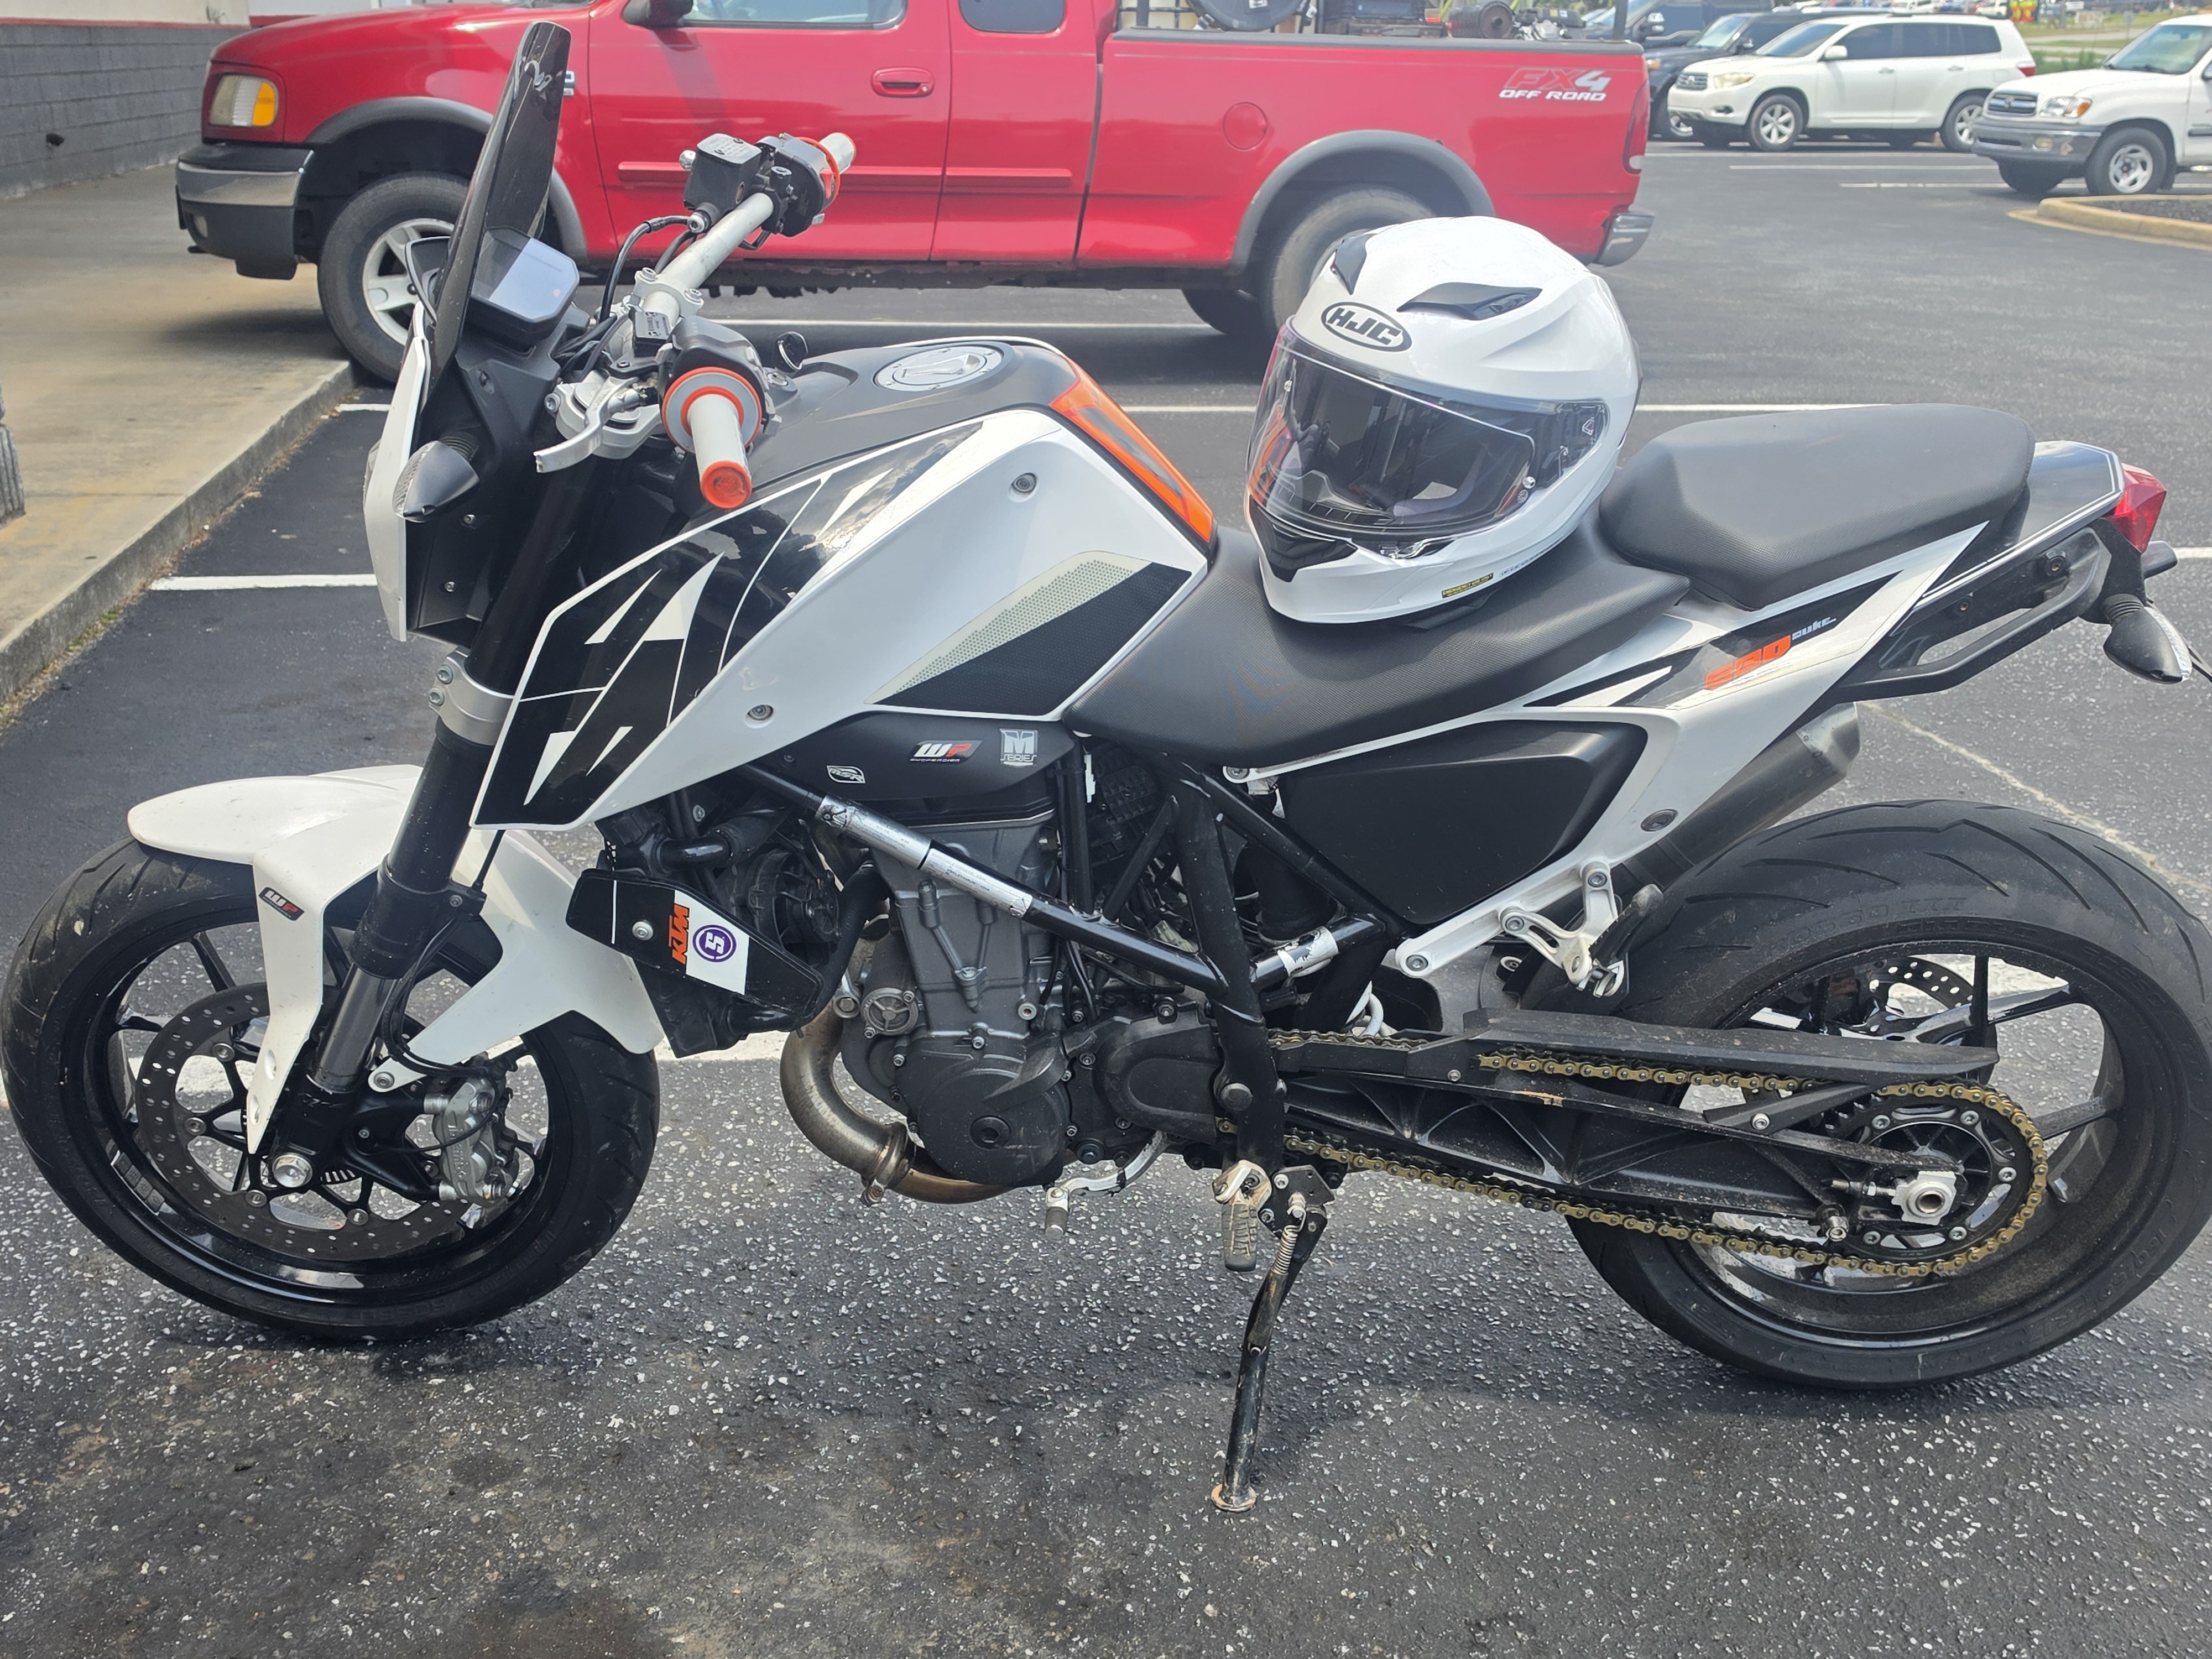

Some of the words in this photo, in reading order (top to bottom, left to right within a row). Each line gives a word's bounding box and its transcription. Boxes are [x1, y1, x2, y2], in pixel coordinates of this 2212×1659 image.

[1503, 66, 1612, 91] FX4
[1499, 89, 1542, 99] OFF
[1545, 91, 1606, 102] ROAD
[1327, 307, 1402, 346] HJC
[914, 743, 972, 757] WP
[1000, 754, 1037, 762] SERIES
[668, 903, 690, 965] KTM
